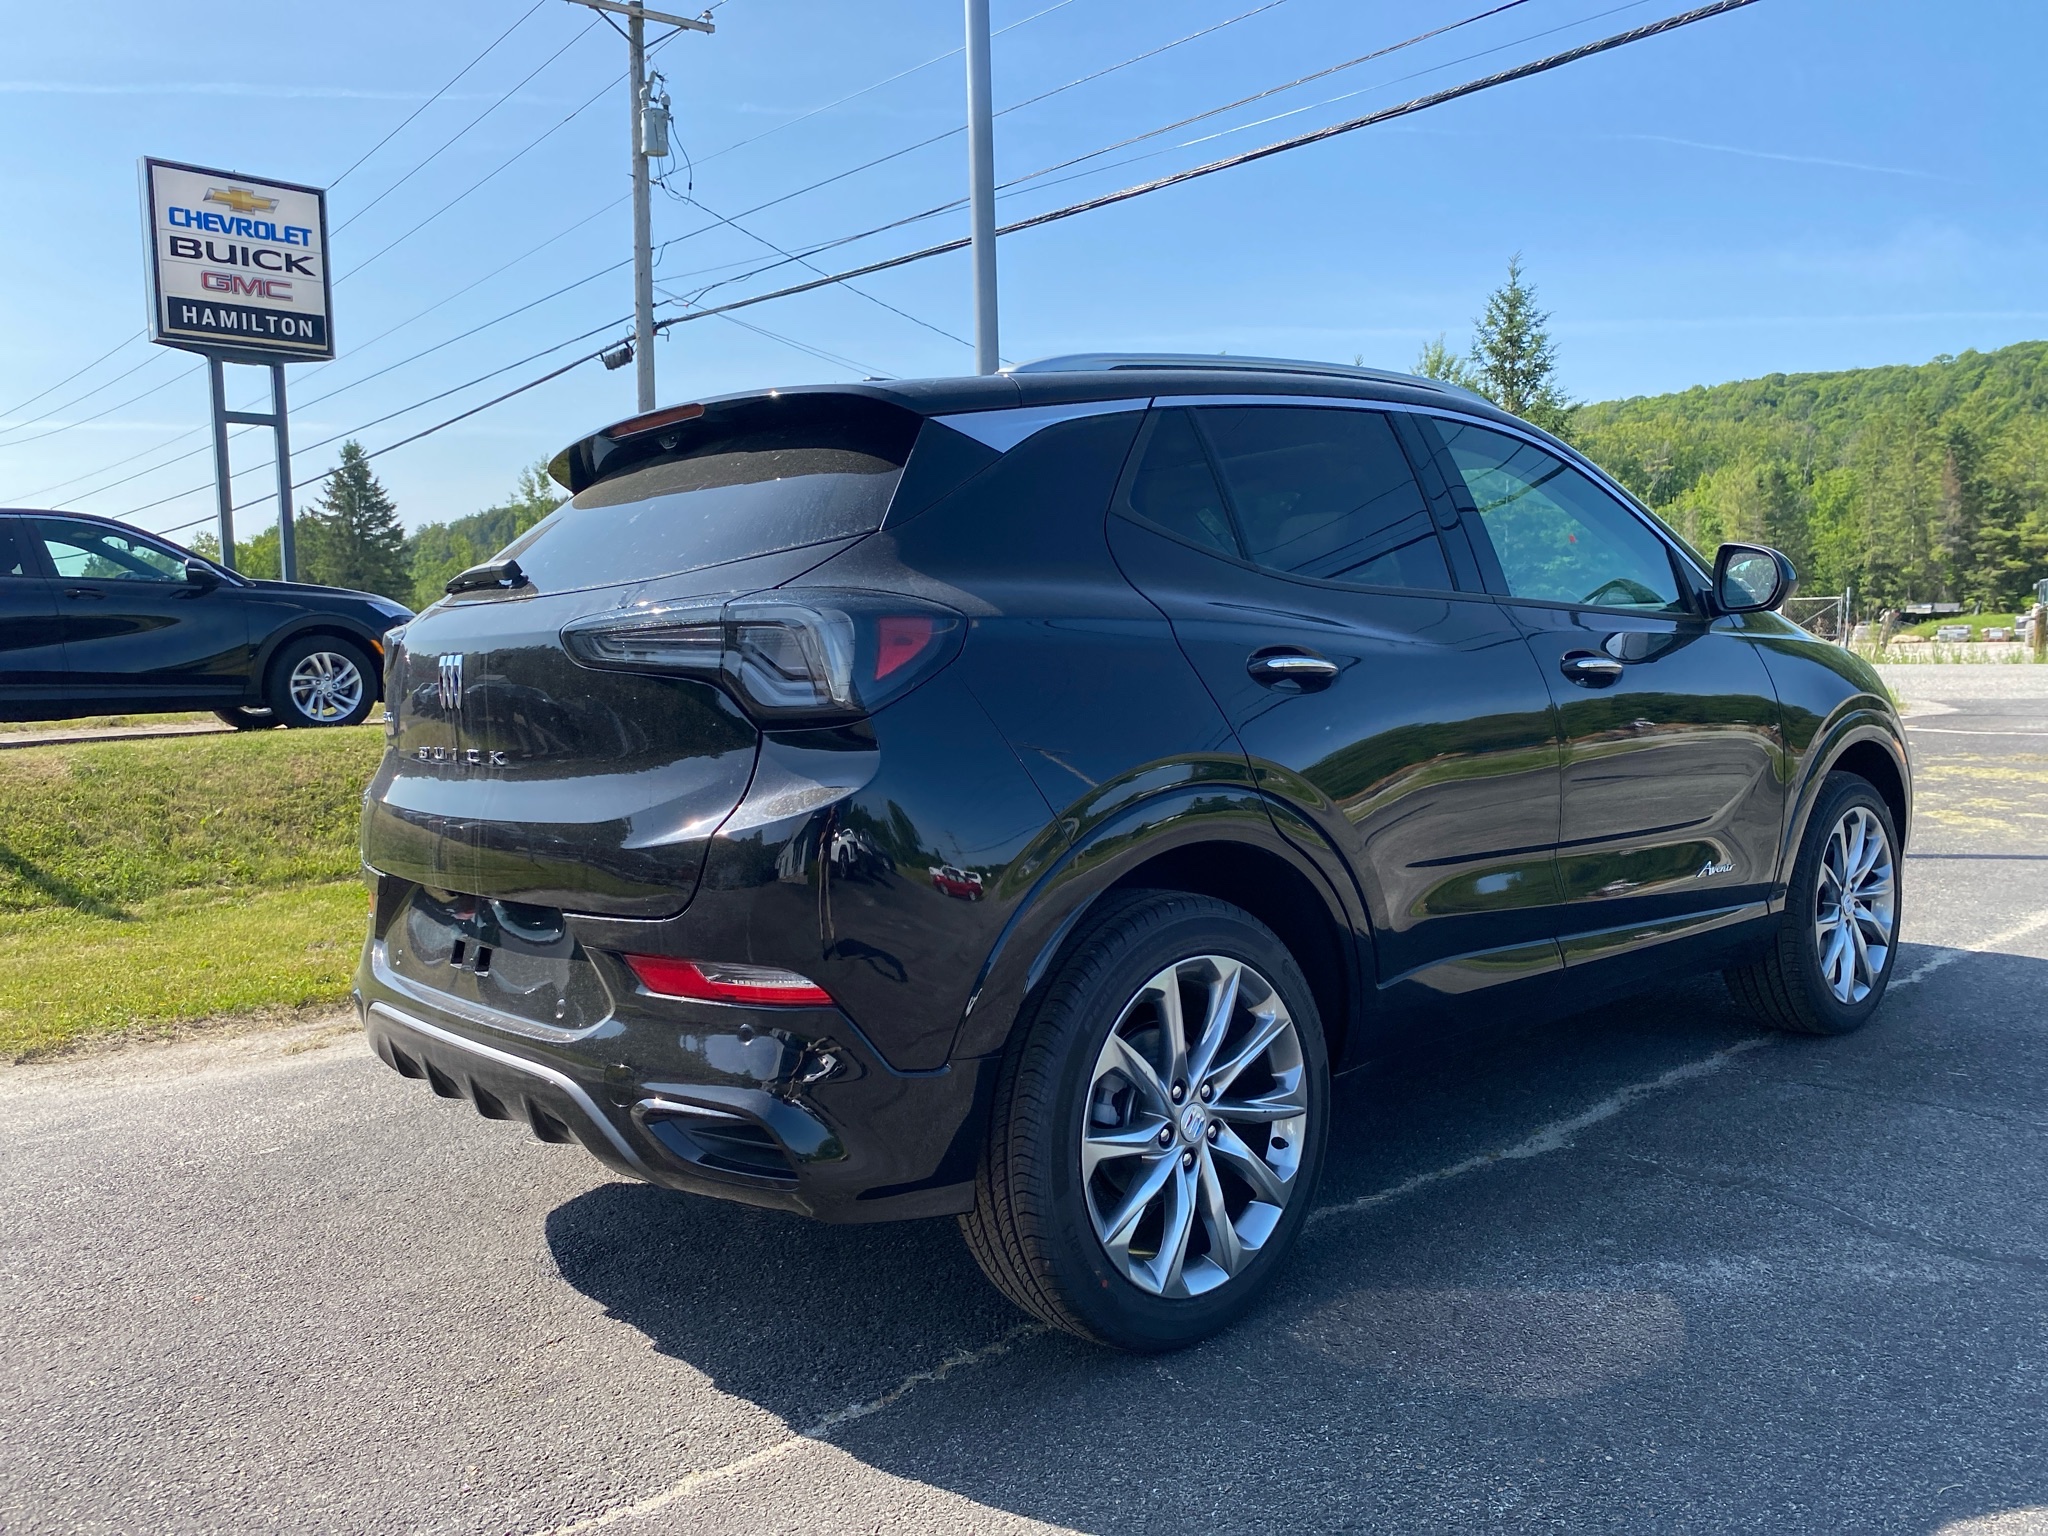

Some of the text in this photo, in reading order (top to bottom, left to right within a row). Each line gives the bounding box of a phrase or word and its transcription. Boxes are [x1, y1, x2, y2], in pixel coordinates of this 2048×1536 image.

[168, 206, 312, 247] CHEVROLET
[169, 235, 316, 277] BUICK
[201, 270, 293, 302] GMC
[182, 305, 313, 338] HAMILTON
[419, 746, 506, 765] BUICK
[1696, 860, 1736, 878] Avenir
